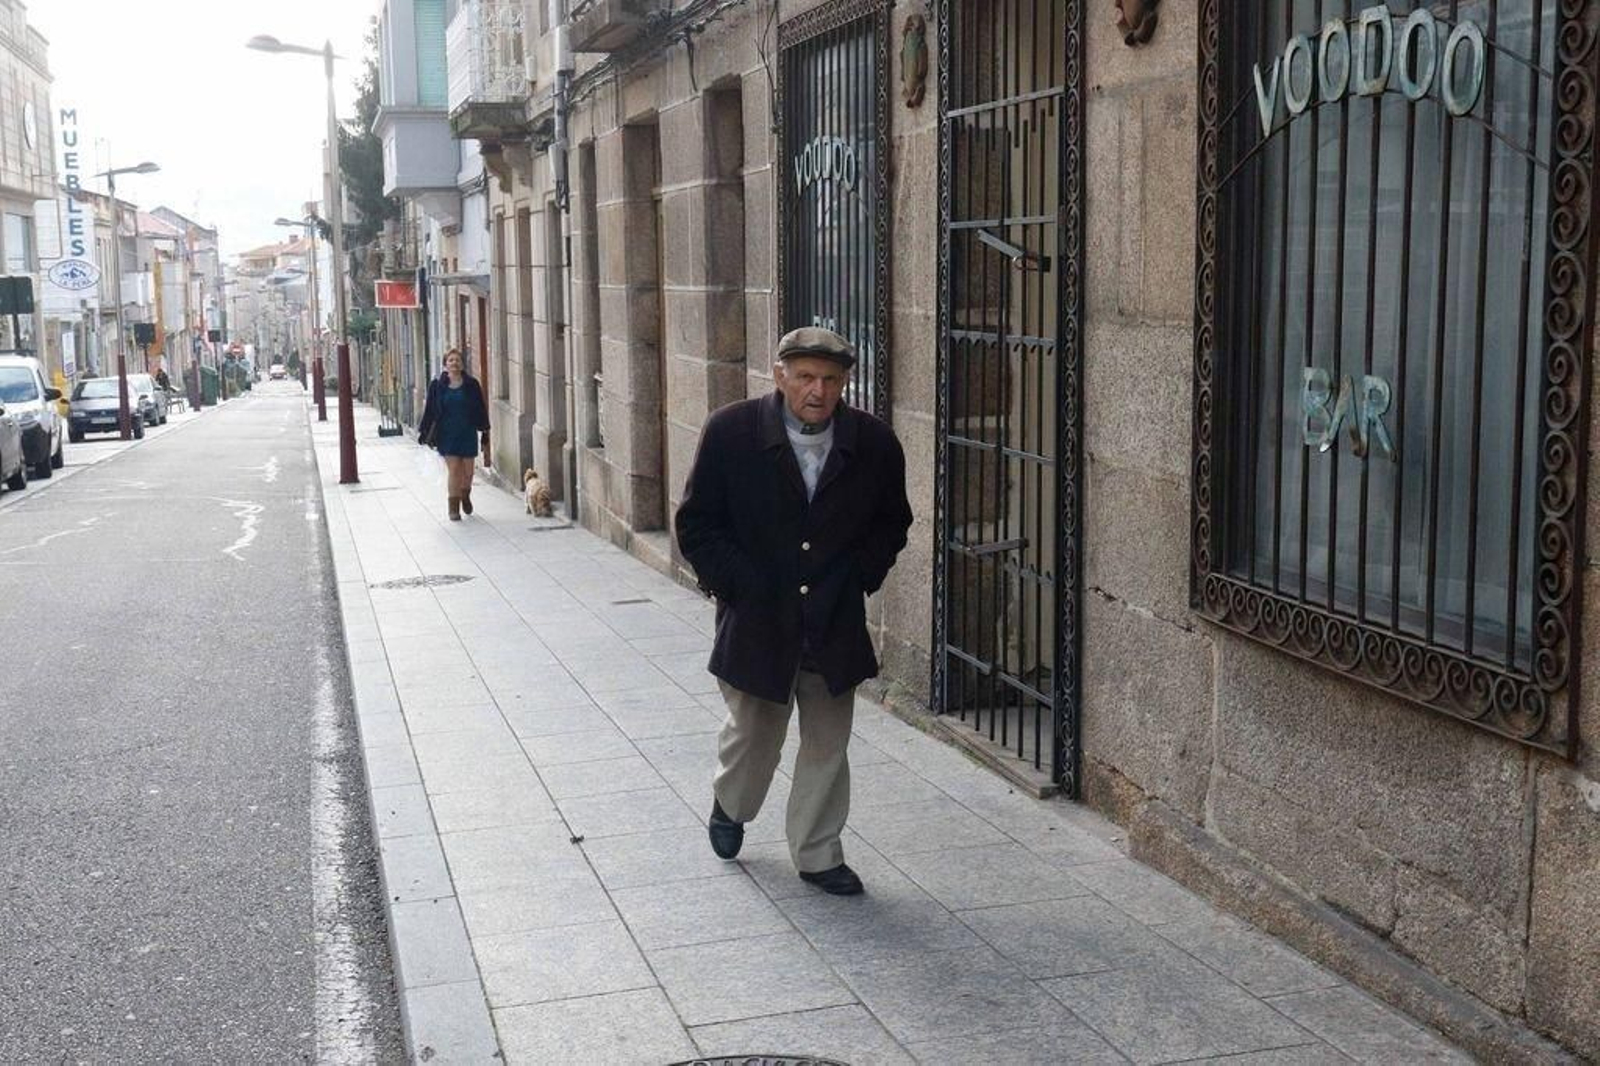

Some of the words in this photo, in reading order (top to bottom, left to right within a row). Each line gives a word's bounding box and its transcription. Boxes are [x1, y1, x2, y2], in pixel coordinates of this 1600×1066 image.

[1253, 4, 1485, 138] VOODOO
[60, 108, 85, 257] MUEBLES
[794, 135, 856, 197] VOODOO
[1303, 366, 1398, 463] BAR
